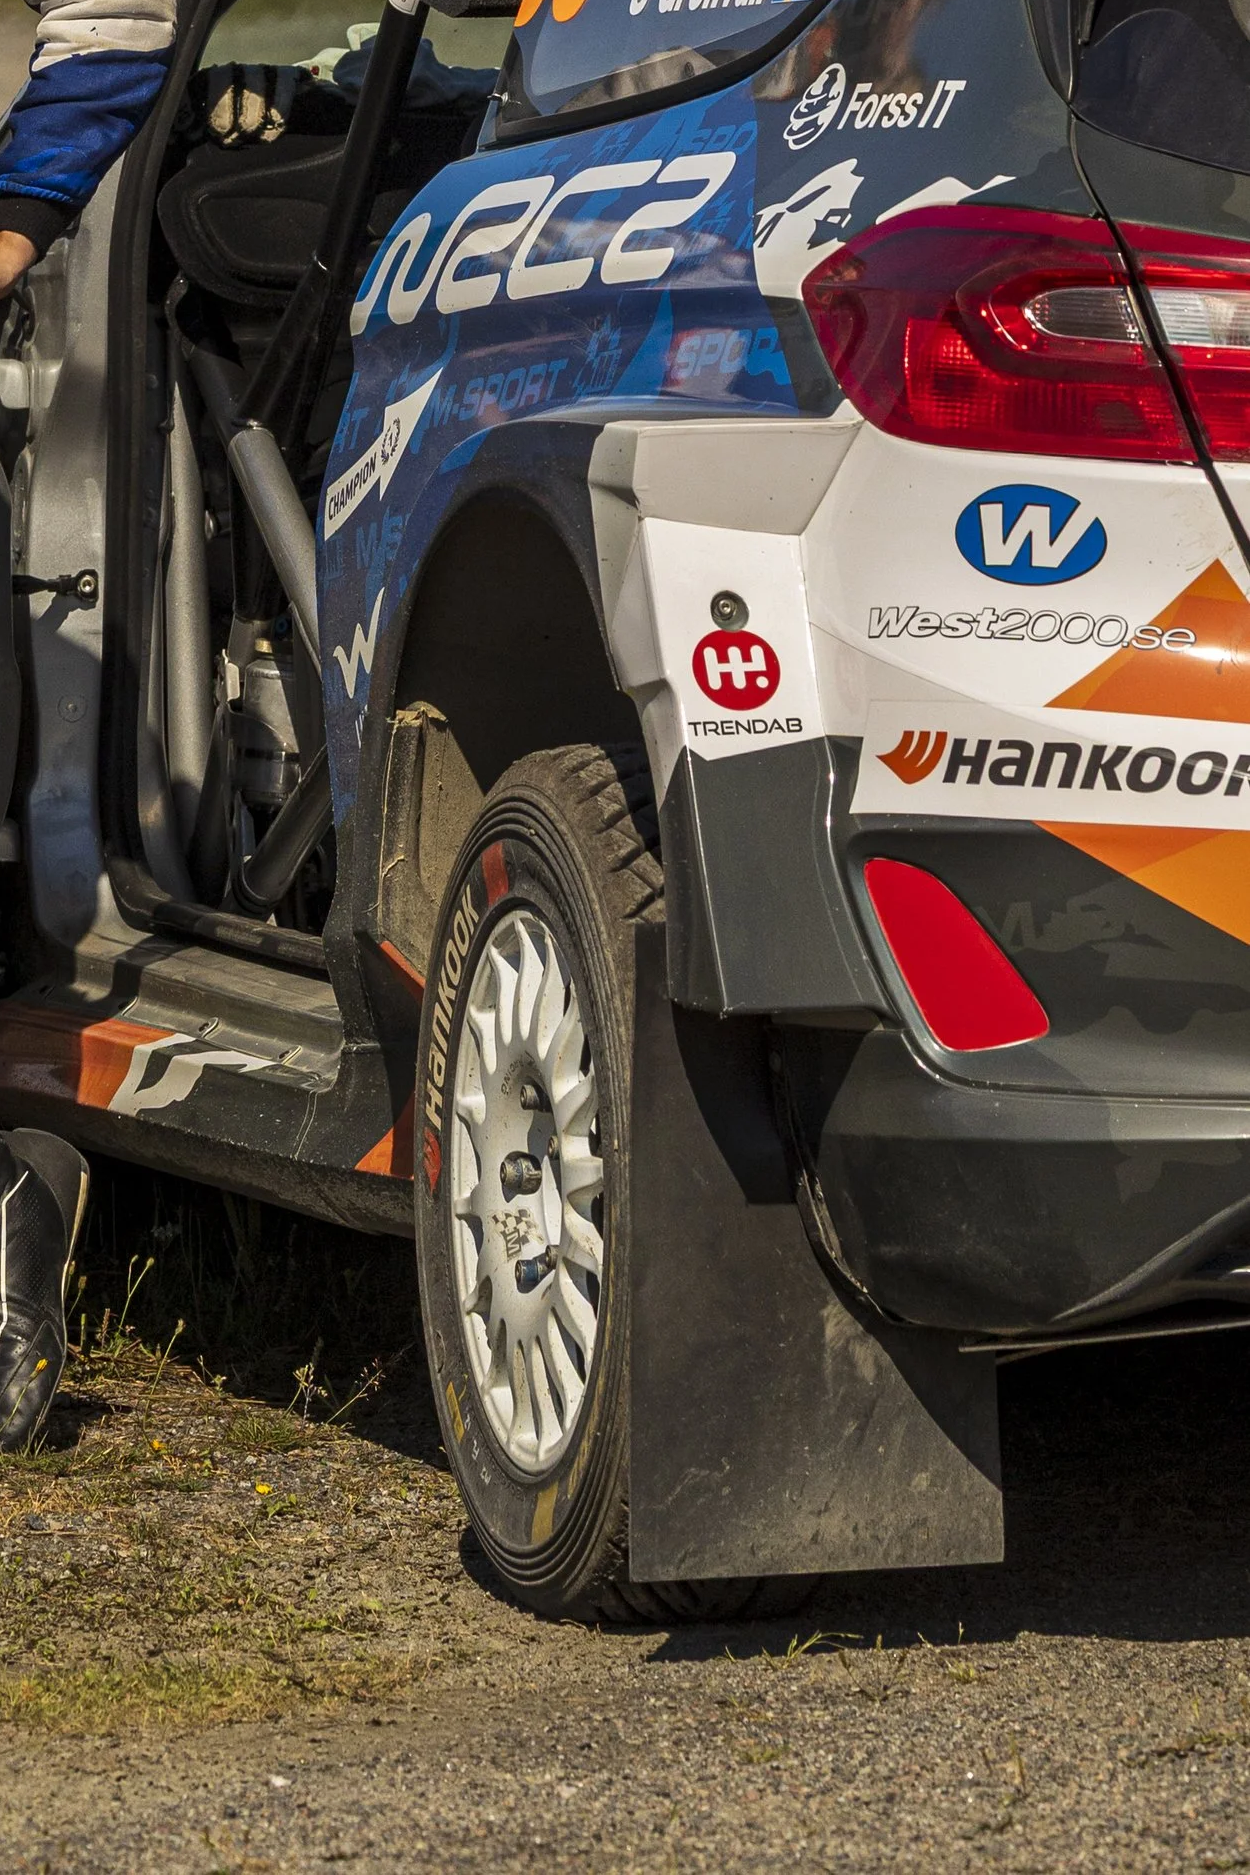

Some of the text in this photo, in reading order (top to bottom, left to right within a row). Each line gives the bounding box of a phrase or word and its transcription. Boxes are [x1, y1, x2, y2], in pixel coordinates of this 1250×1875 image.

[837, 79, 967, 131] Forss IT
[328, 452, 377, 521] CHAMPION
[867, 605, 1196, 652] West2000.se
[688, 717, 803, 737] TRENDAB
